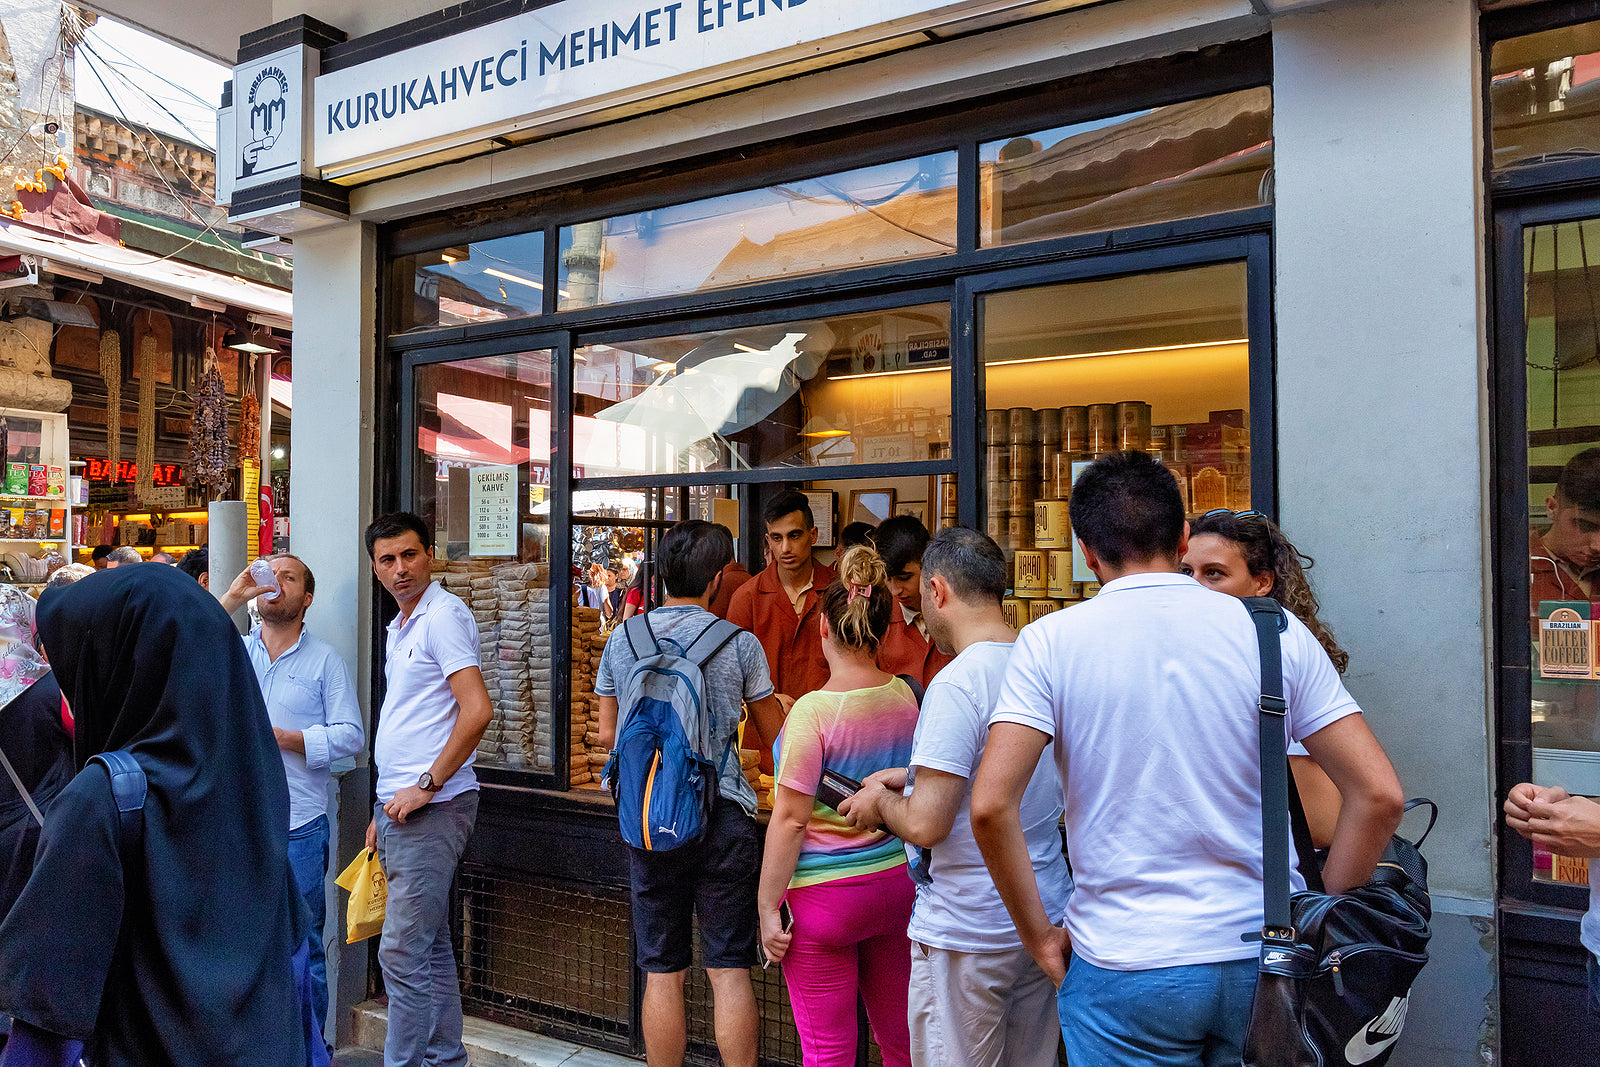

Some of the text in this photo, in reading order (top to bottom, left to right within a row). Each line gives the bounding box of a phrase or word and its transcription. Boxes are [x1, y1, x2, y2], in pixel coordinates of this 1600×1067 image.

[326, 0, 808, 135] KURUKAHVECİ MEHMET EFE
[9, 469, 26, 477] TEA
[29, 470, 46, 479] TEA
[89, 461, 175, 482] BAHAAT
[477, 472, 510, 484] ÇEKİLMİŞ
[481, 483, 504, 492] KAHVE
[1018, 555, 1041, 581] KAKAO
[1544, 630, 1587, 647] FILTER
[1544, 647, 1588, 664] COFFEE
[1267, 951, 1287, 960] NIKE
